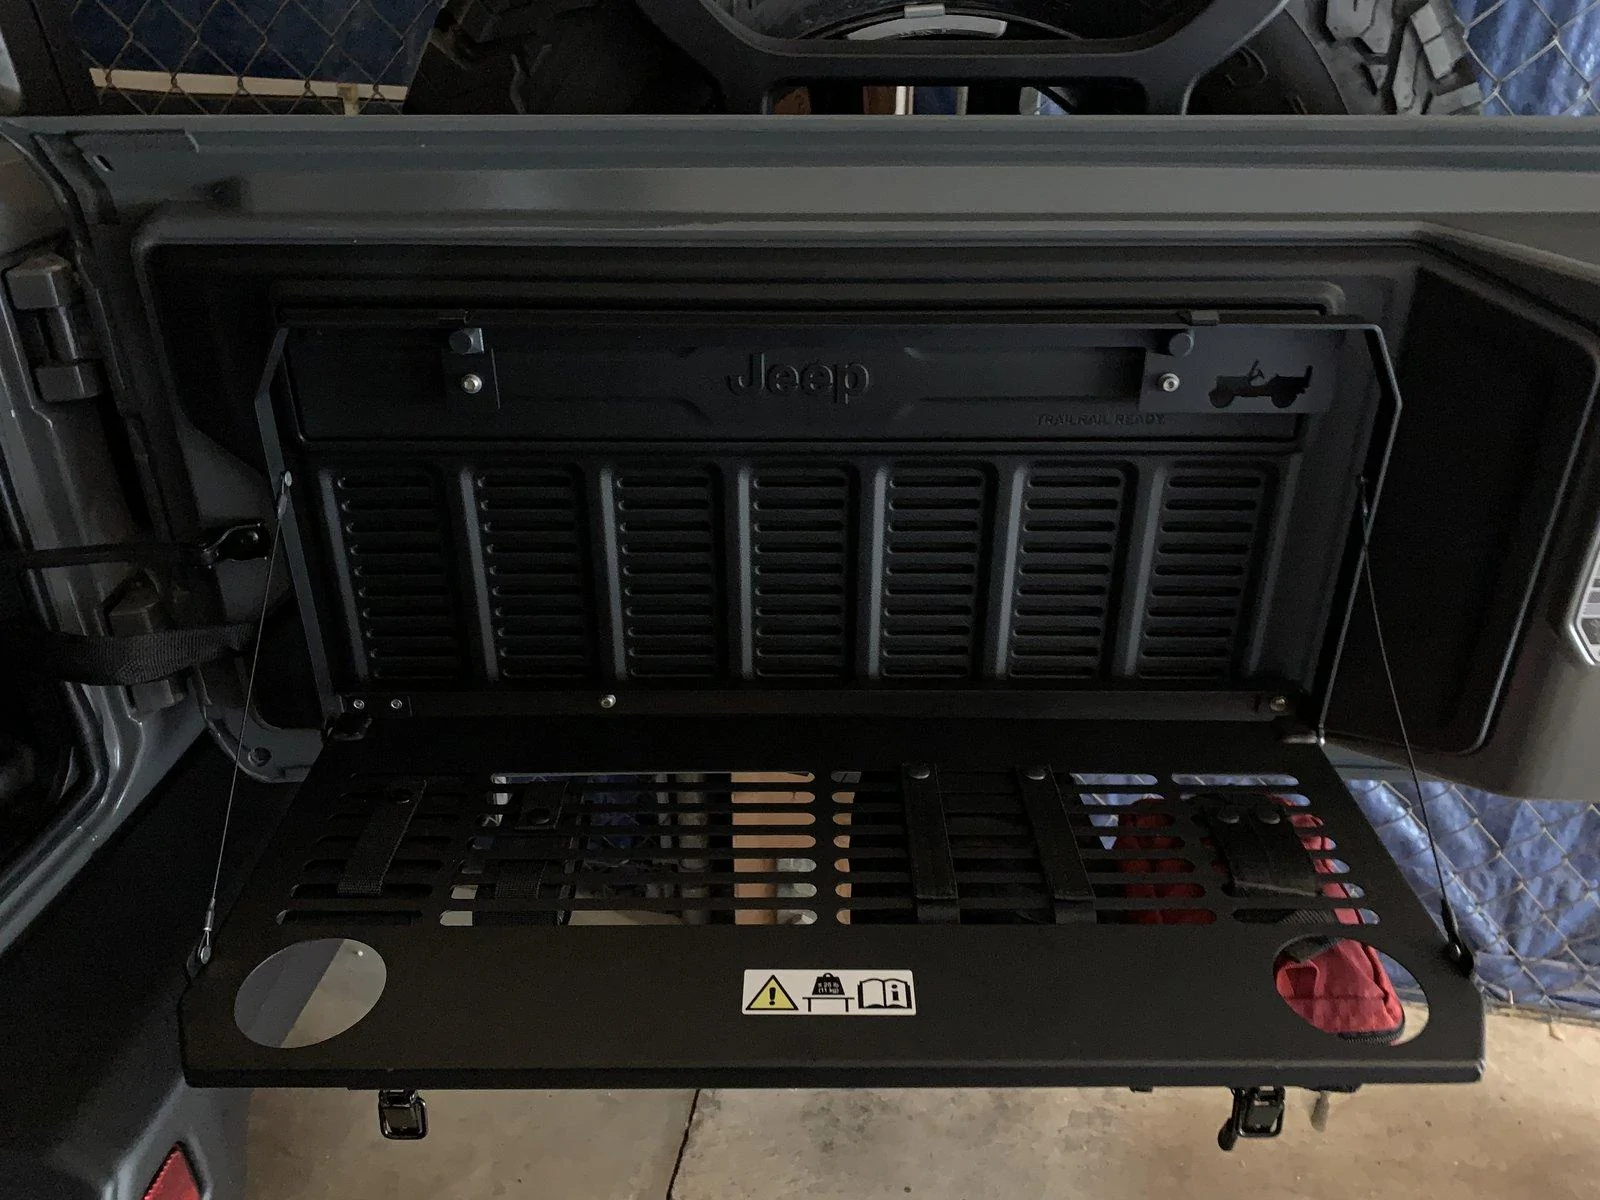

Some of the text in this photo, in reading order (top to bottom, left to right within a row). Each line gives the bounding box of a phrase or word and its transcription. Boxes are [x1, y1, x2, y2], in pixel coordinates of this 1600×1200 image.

[725, 351, 870, 405] Jeep
[1037, 412, 1165, 426] TRAILRAIL READY
